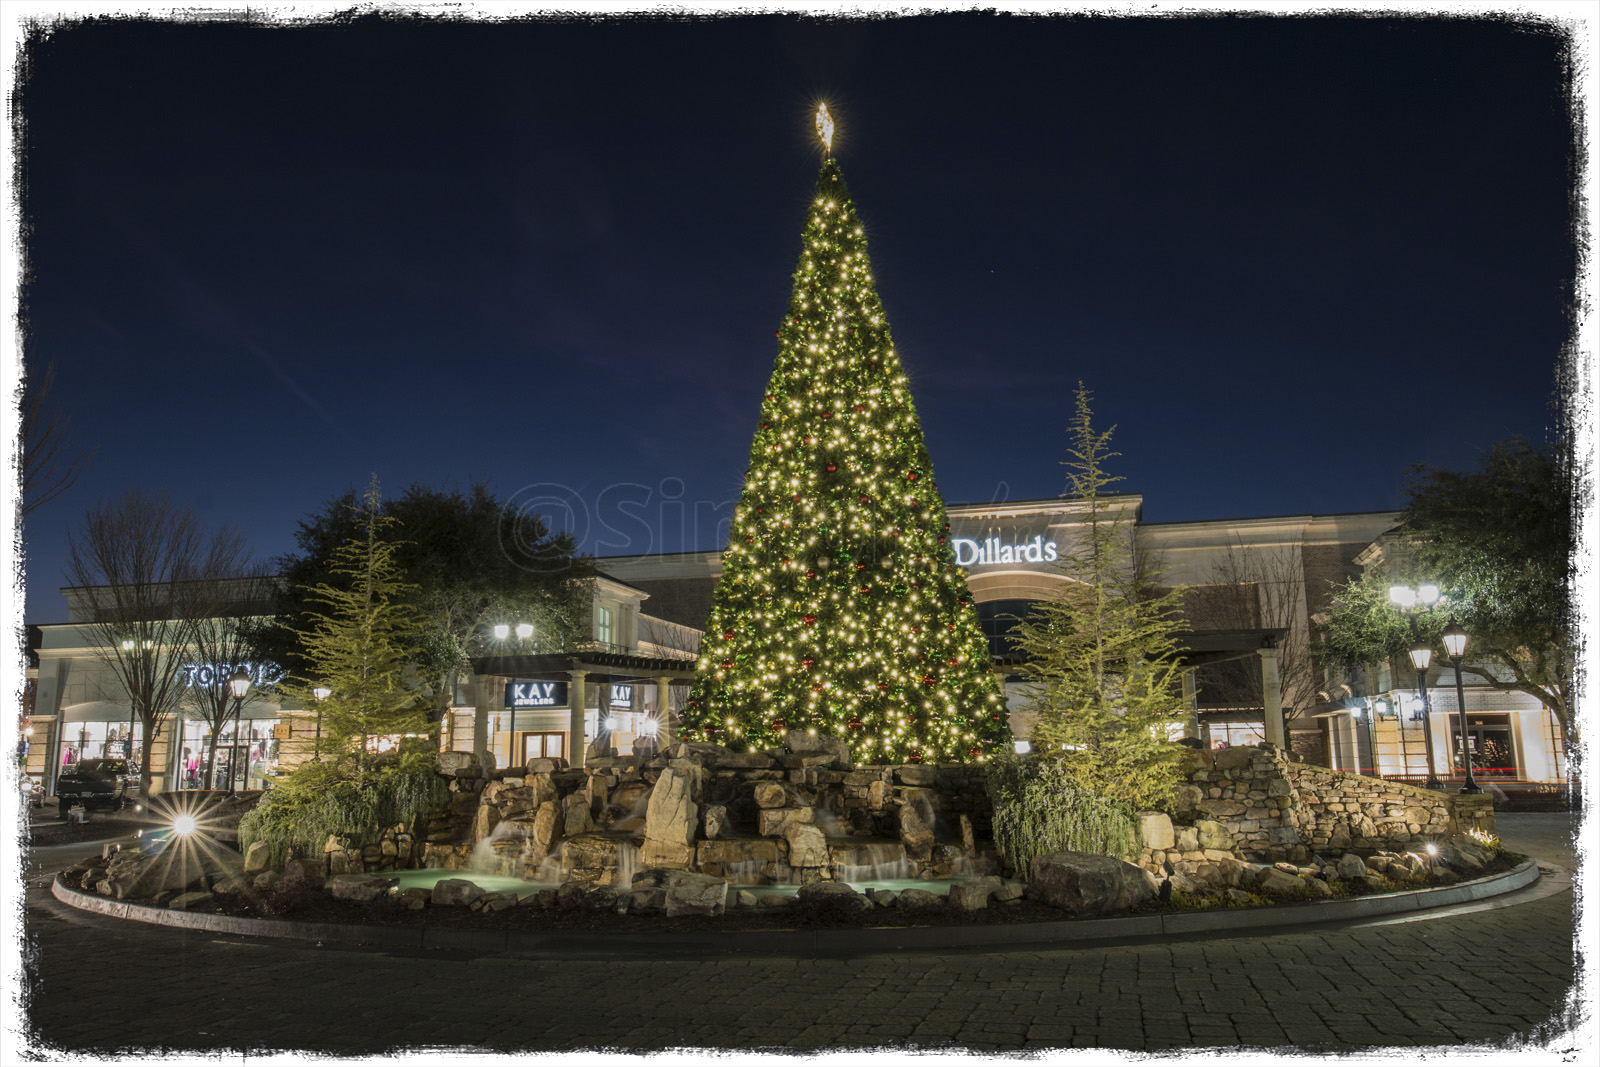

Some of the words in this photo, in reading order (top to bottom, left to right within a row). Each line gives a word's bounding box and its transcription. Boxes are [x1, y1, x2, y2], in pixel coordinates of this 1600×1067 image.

[514, 683, 555, 699] KAY
[611, 685, 631, 700] KAY
[514, 698, 555, 706] JEWELERS
